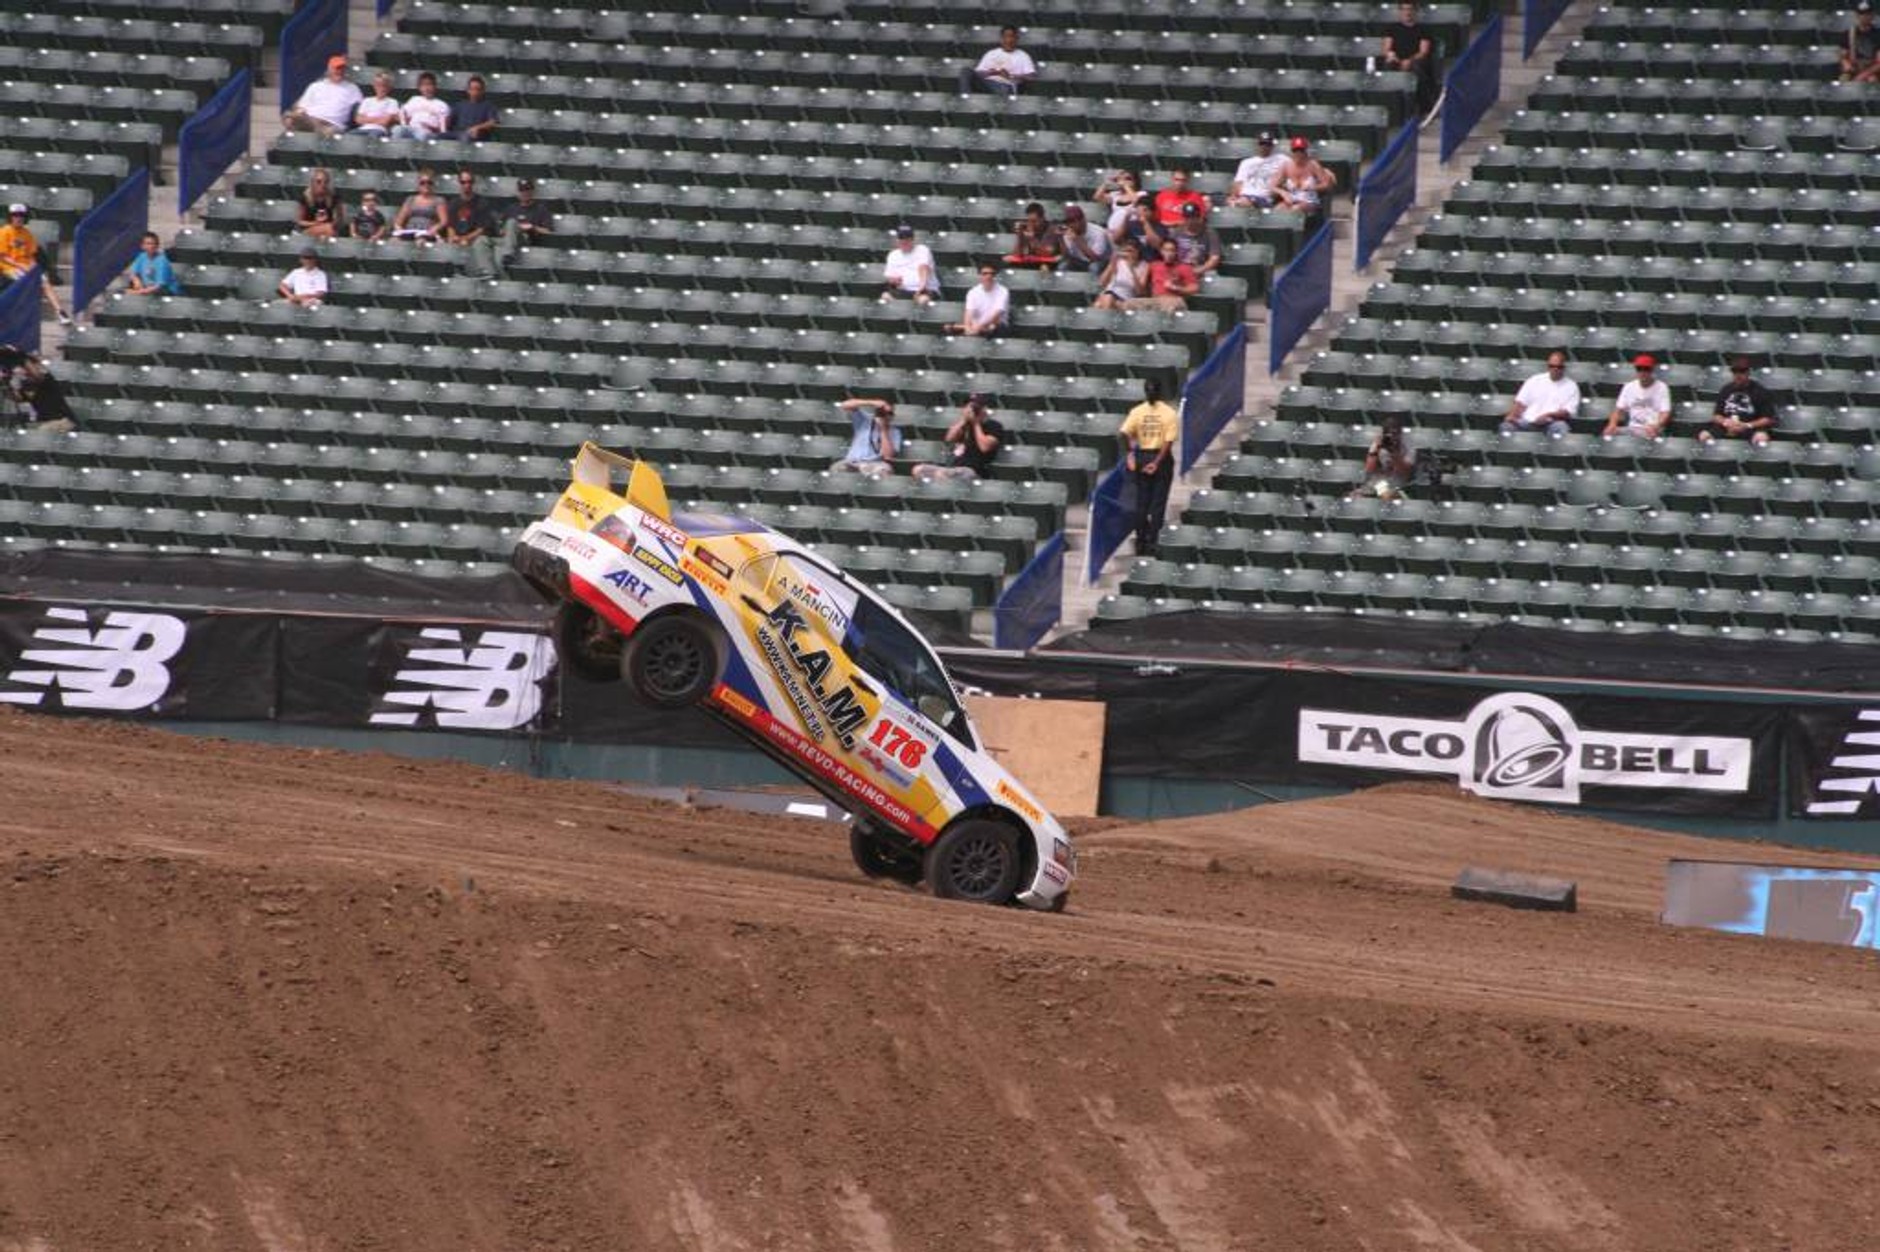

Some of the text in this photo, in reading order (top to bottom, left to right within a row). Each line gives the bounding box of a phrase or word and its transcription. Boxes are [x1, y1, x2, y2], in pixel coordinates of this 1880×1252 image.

[641, 514, 687, 547] WRC
[604, 569, 652, 600] ART
[769, 600, 868, 750] K.A.M.
[869, 718, 927, 769] 176
[1317, 722, 1727, 777] TACO BELL
